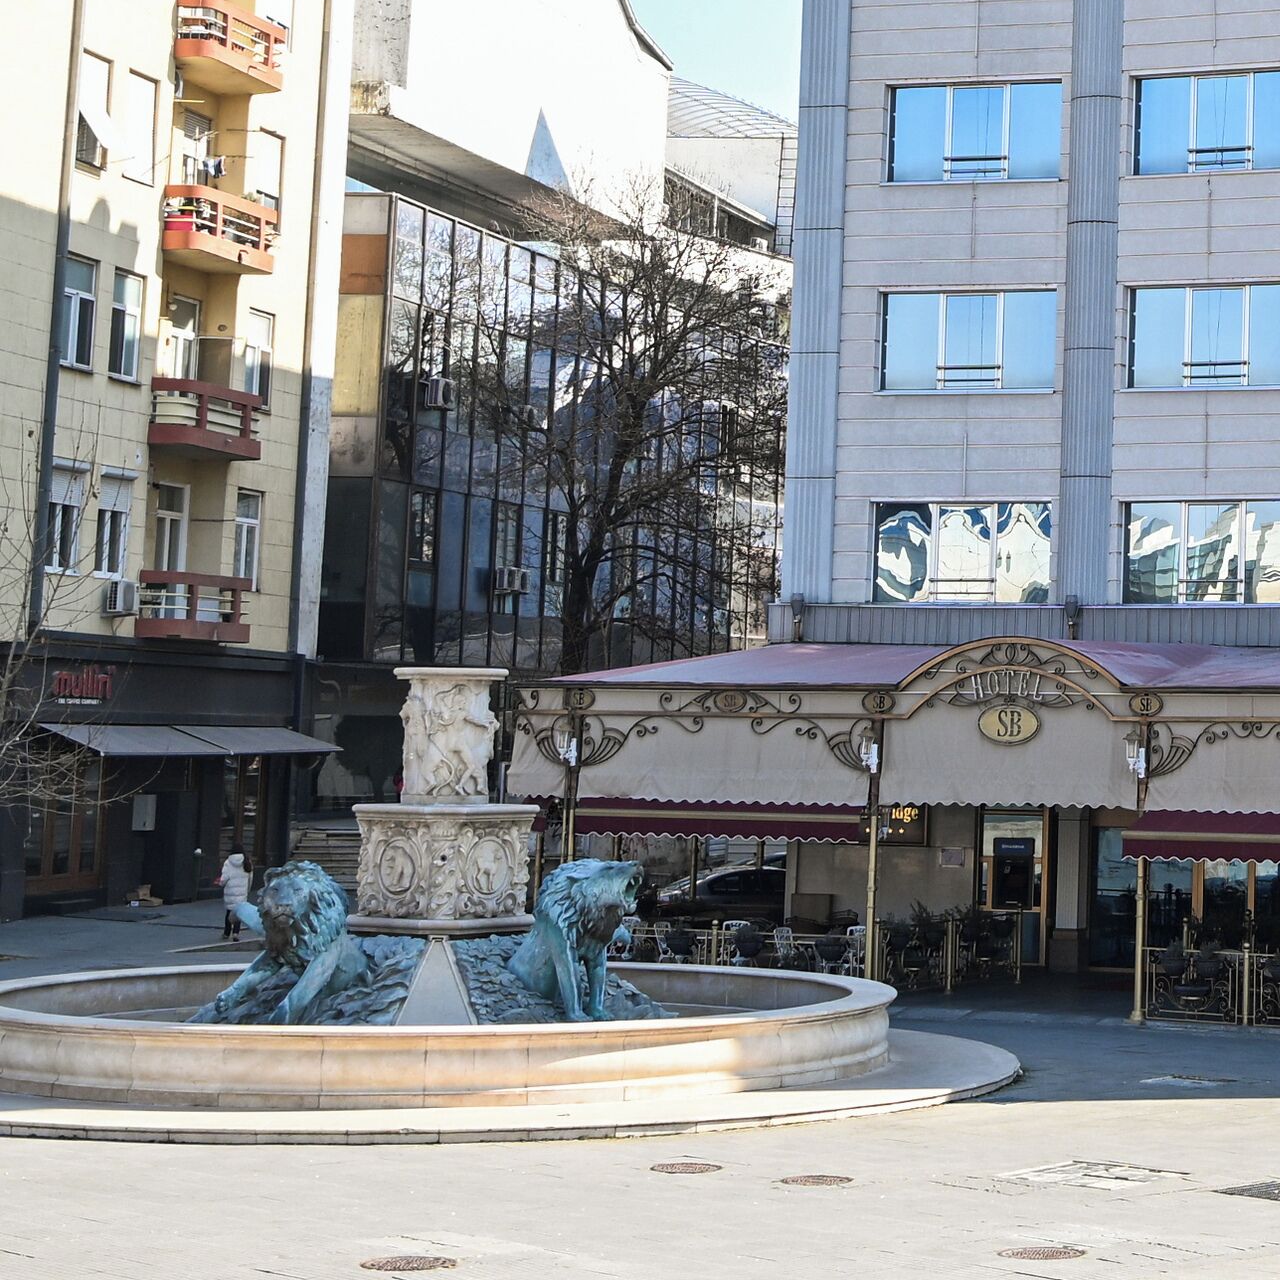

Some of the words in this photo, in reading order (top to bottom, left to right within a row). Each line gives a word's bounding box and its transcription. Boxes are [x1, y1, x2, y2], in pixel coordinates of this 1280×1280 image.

[971, 669, 1045, 701] HOTEL
[573, 692, 585, 706] SB
[872, 695, 886, 709] SB
[997, 709, 1023, 738] SB
